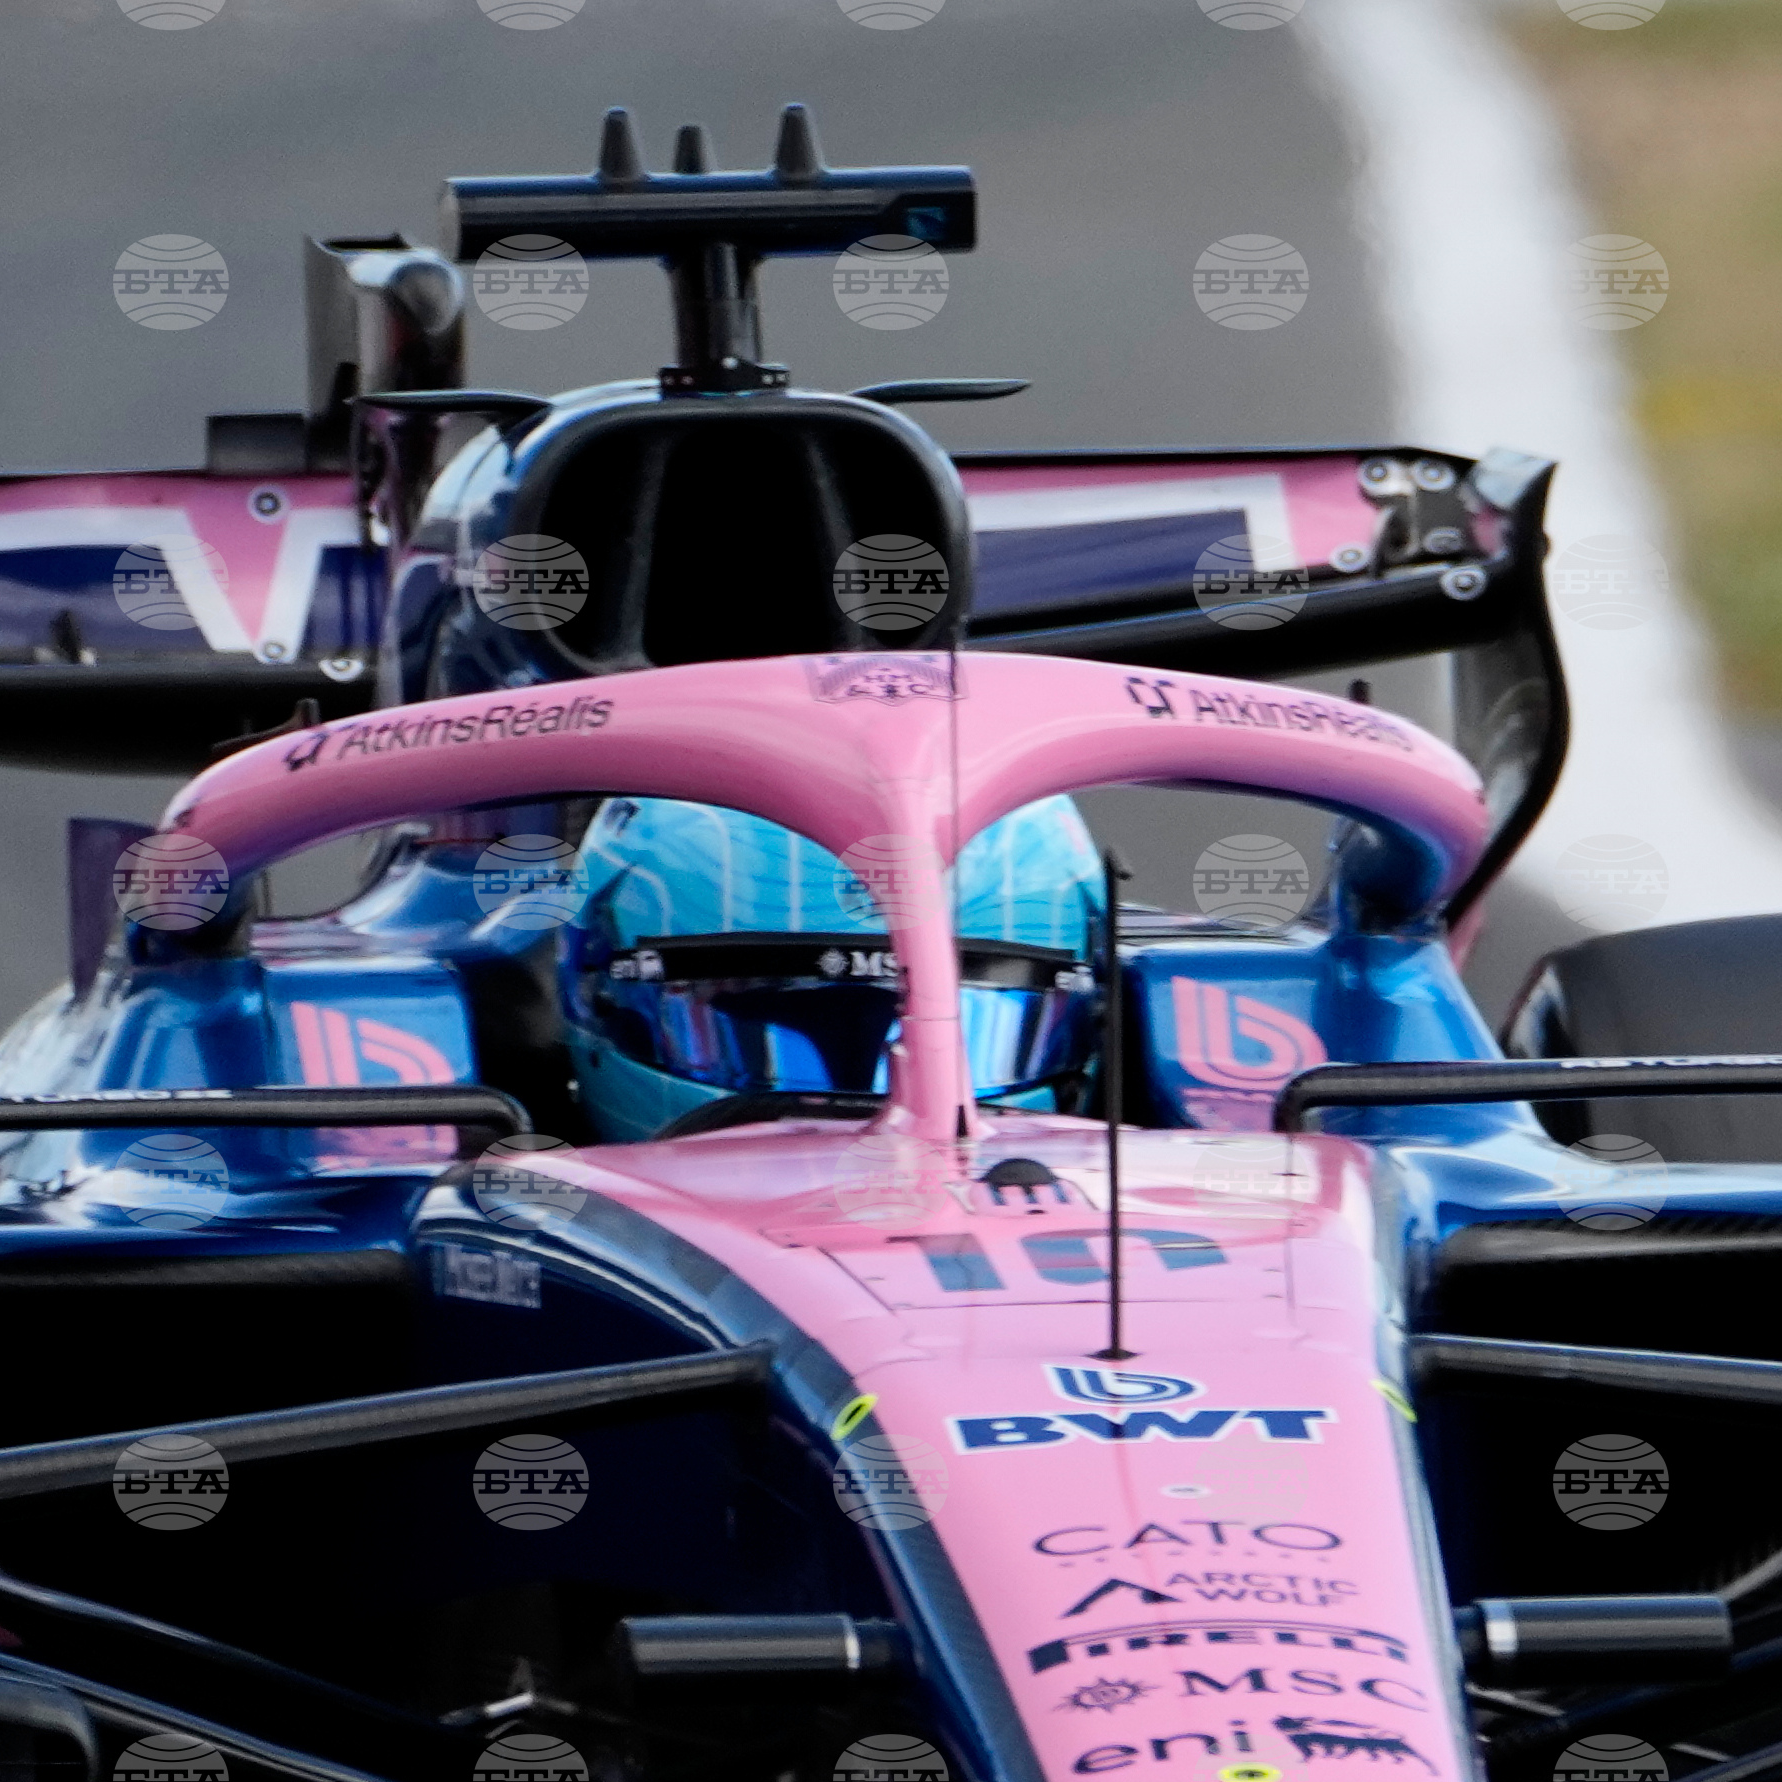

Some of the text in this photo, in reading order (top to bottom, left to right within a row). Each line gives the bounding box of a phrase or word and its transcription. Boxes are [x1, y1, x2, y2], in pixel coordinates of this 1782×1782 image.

[955, 1409, 1328, 1449] BWT
[1032, 1521, 1342, 1556] CATO
[1165, 1571, 1359, 1596] ARCTIC
[1194, 1588, 1338, 1608] WOLF
[1027, 1618, 1410, 1676] PIRELLI
[1171, 1667, 1430, 1713] MSC
[1072, 1719, 1256, 1776] eni
